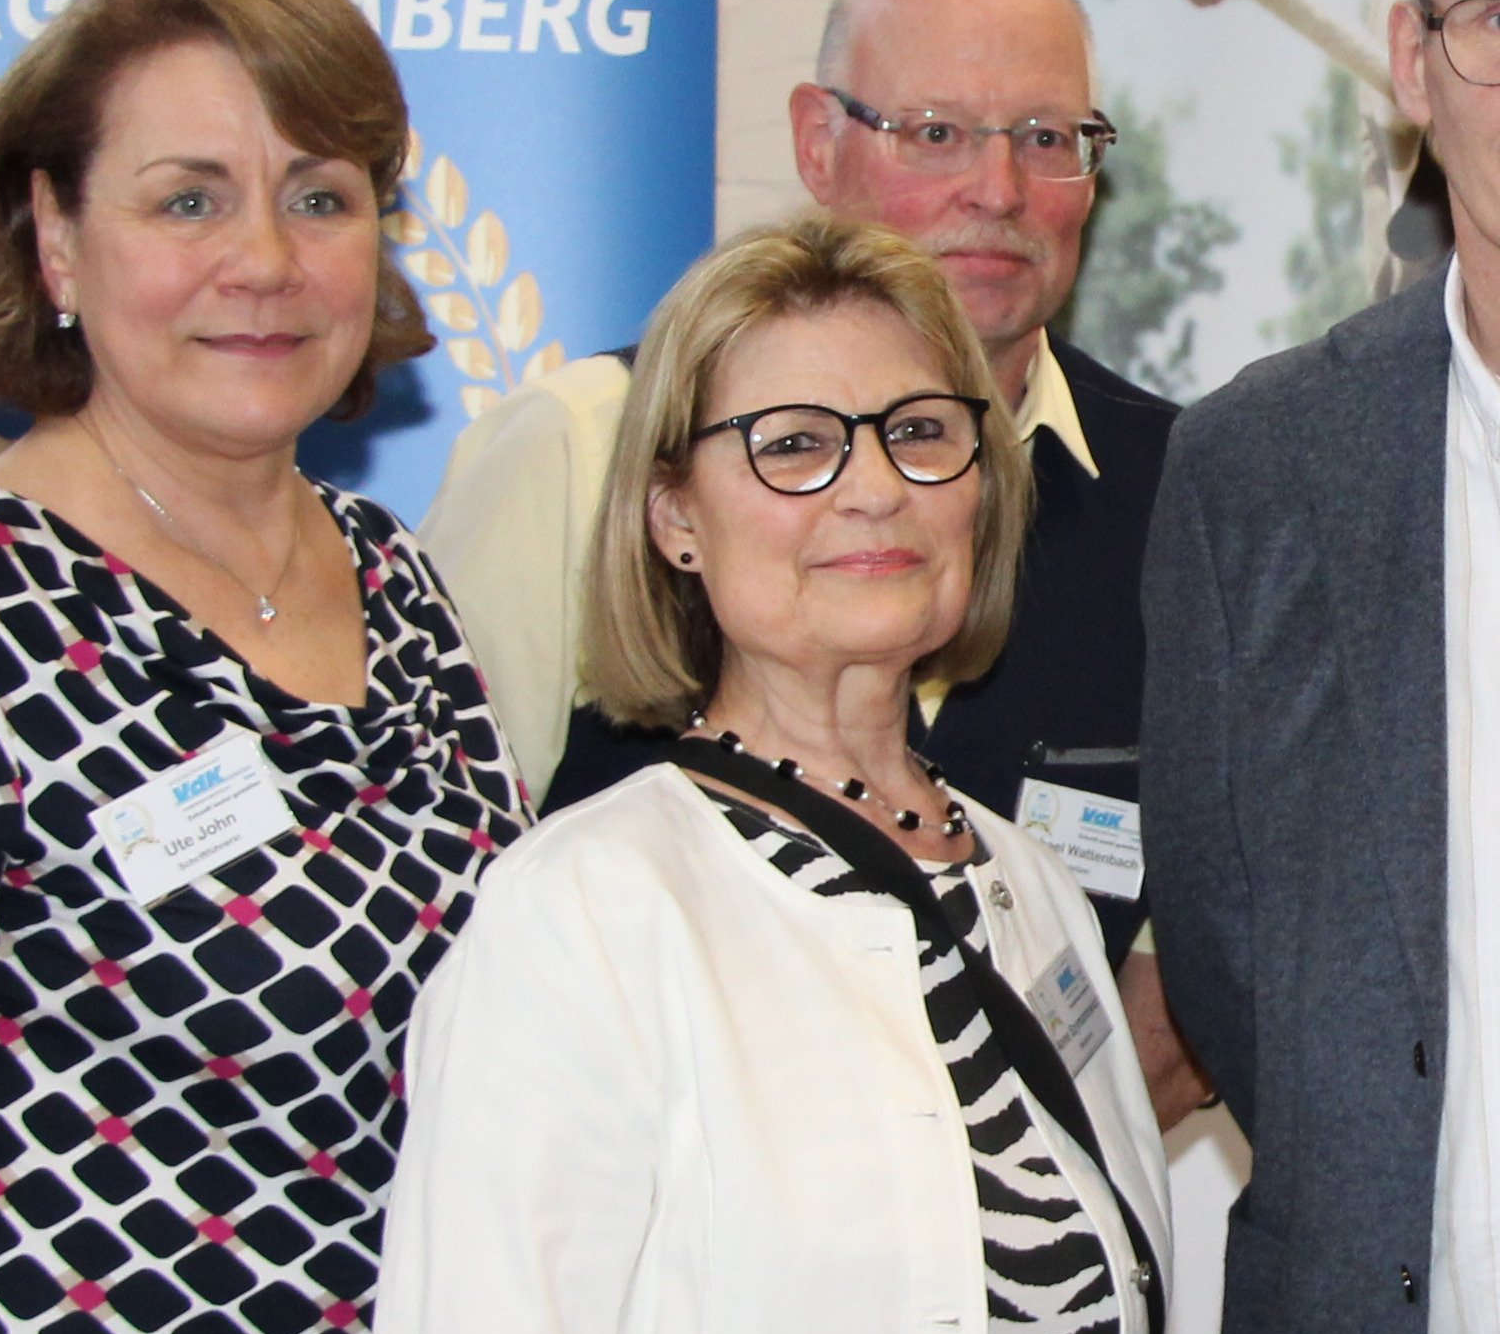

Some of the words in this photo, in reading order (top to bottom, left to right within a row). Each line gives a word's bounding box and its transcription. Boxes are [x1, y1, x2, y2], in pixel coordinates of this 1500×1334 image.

[171, 764, 226, 806] VdK
[163, 835, 195, 858] Ute
[198, 813, 238, 842] John
[1067, 842, 1139, 870] Wattenbach
